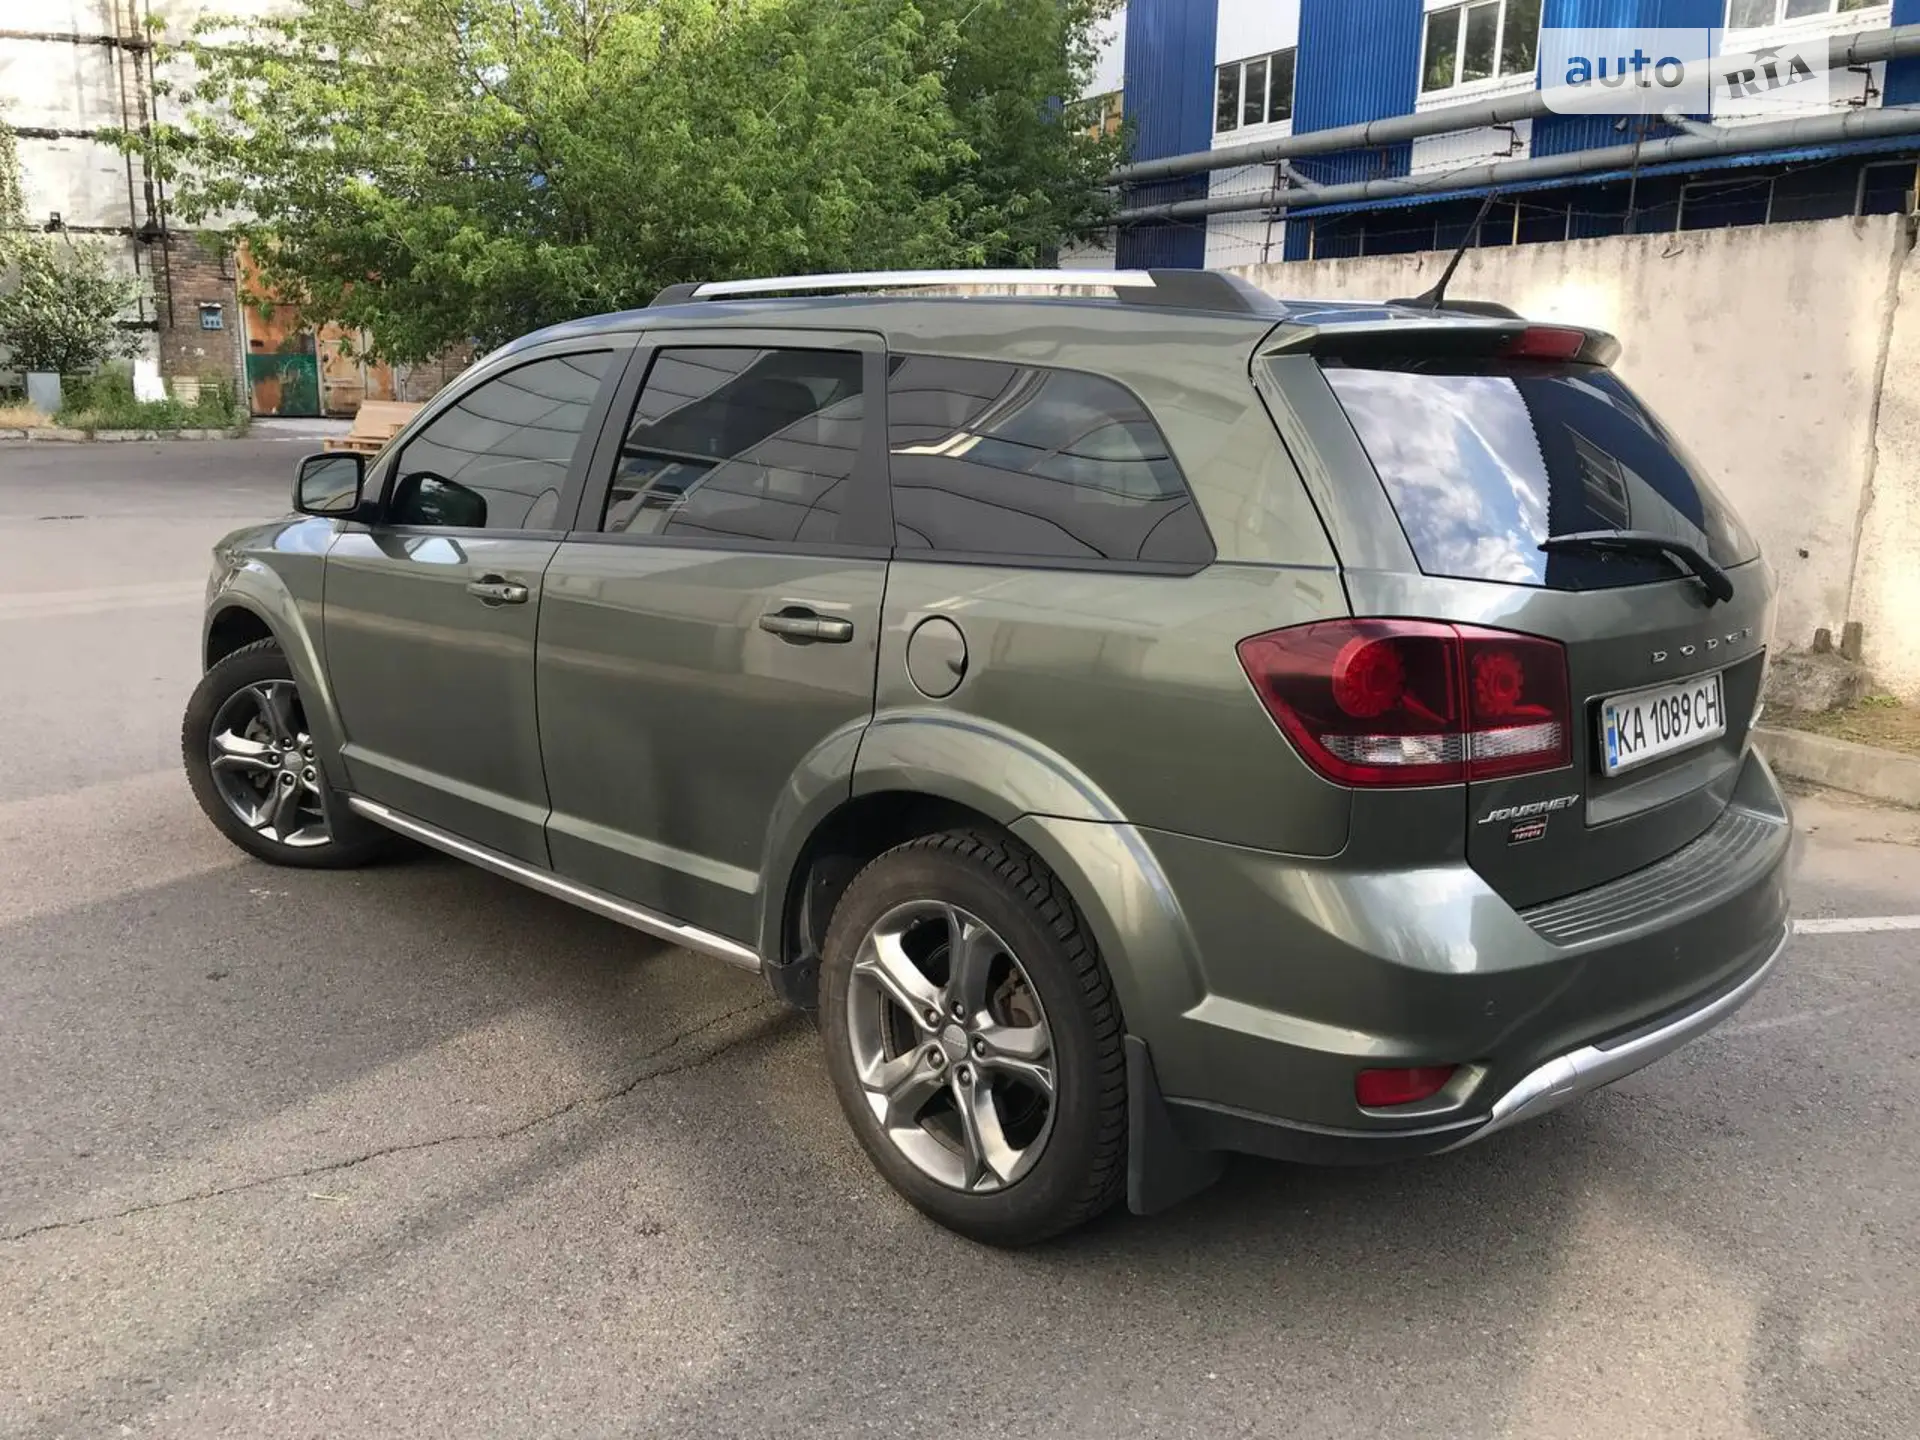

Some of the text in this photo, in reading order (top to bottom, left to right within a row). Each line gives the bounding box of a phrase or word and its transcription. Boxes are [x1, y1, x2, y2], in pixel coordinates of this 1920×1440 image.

[1617, 684, 1719, 757] KA 1089 CH
[1478, 794, 1580, 824] JOURNEY
